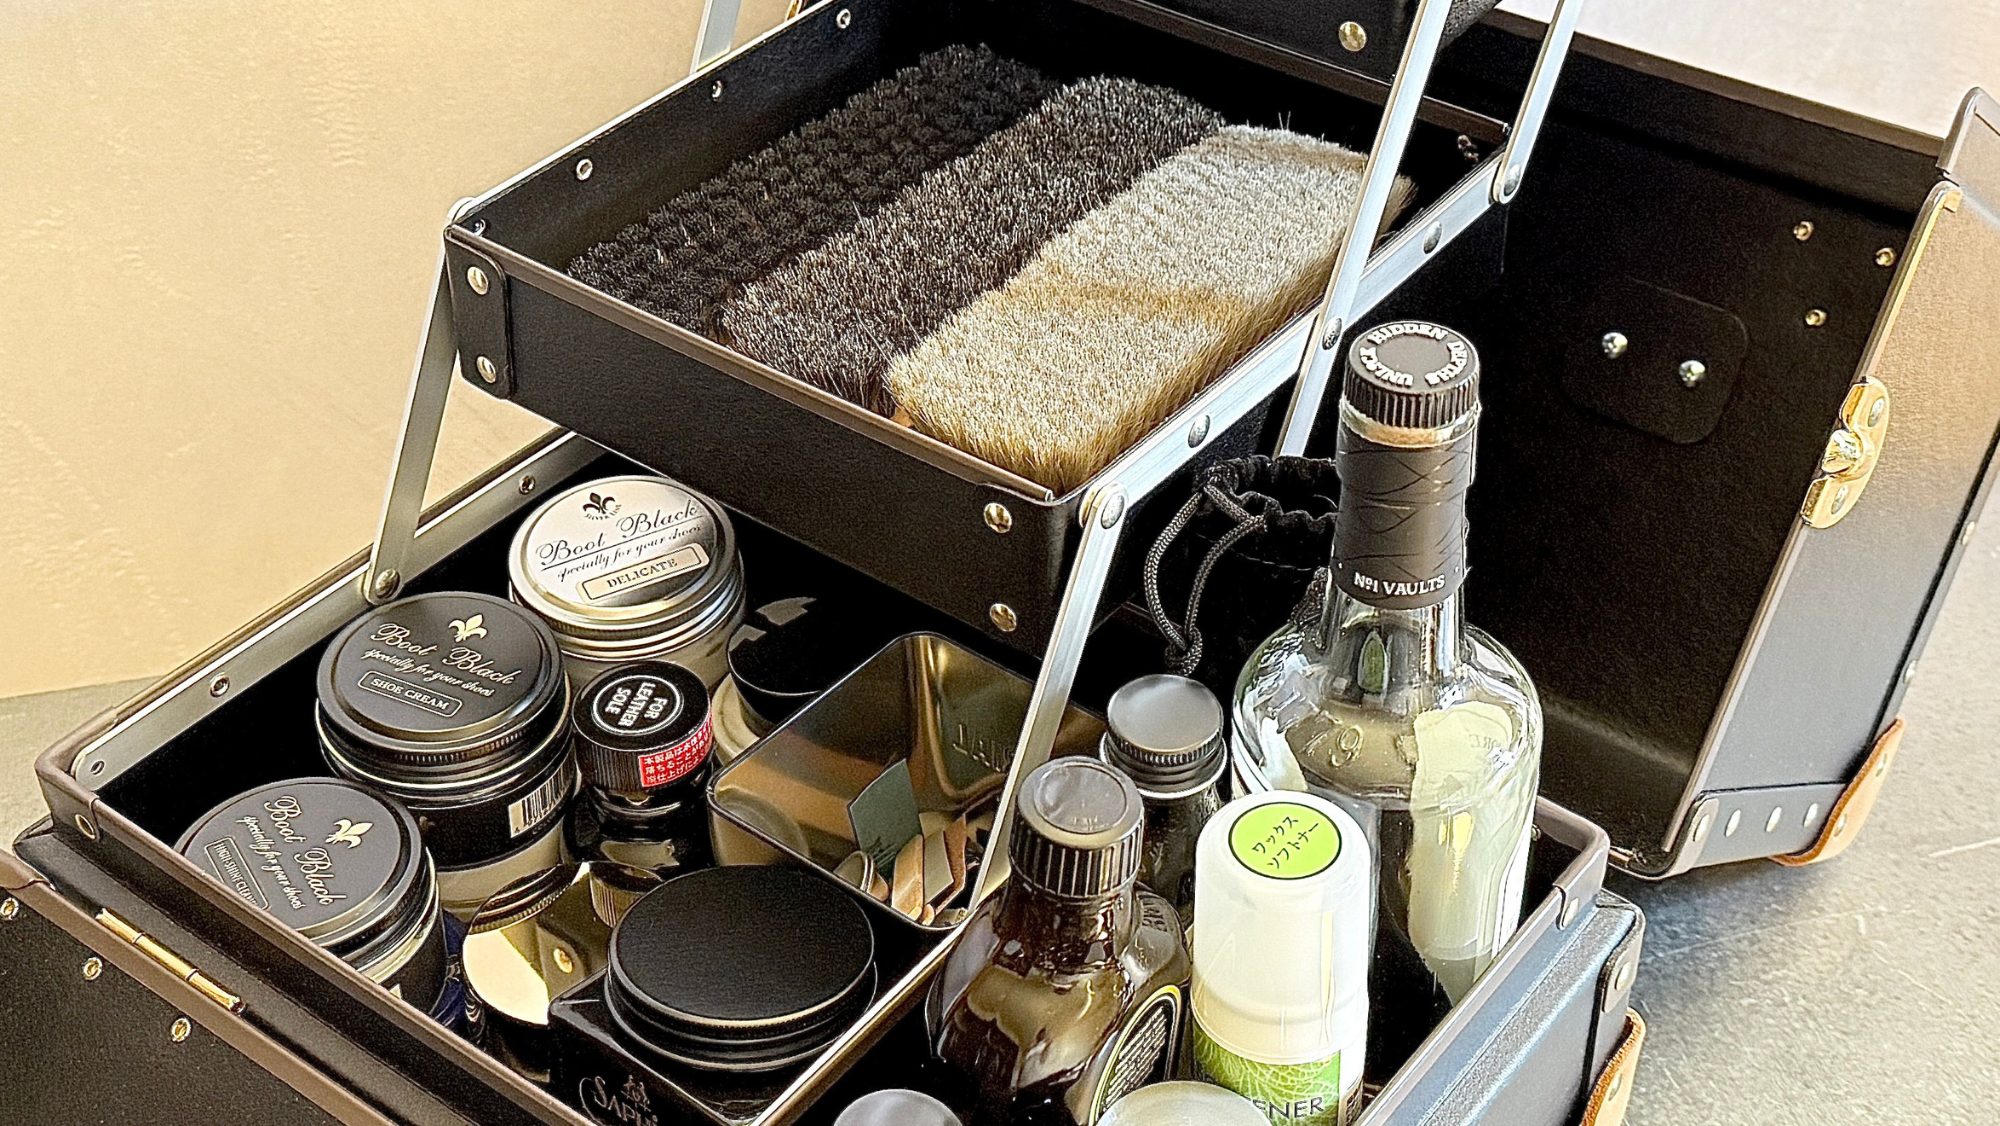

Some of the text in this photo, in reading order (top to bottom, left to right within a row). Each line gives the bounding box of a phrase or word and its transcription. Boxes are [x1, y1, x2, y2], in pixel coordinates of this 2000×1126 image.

[1367, 323, 1448, 345] HIDDEN
[1424, 340, 1468, 386] DEPTHS
[536, 499, 698, 566] Boot Black
[612, 547, 633, 563] for
[635, 537, 666, 557] your
[668, 524, 701, 540] shoes
[606, 558, 678, 588] DELICATE
[1382, 574, 1445, 596] VAULTS
[370, 623, 522, 685] Boot Black
[371, 677, 450, 710] SHOE CREAM
[409, 663, 434, 677] for
[422, 671, 461, 687] your
[461, 679, 496, 698] shoes
[605, 686, 632, 715] SOLE
[618, 681, 656, 727] LEATHER
[643, 697, 668, 720] FOR
[263, 795, 347, 906] Boot Black
[1251, 816, 1299, 854] ワックス
[1267, 822, 1319, 870] ソフトナー
[254, 849, 282, 866] for
[261, 865, 290, 886] your
[282, 884, 307, 910] shoes
